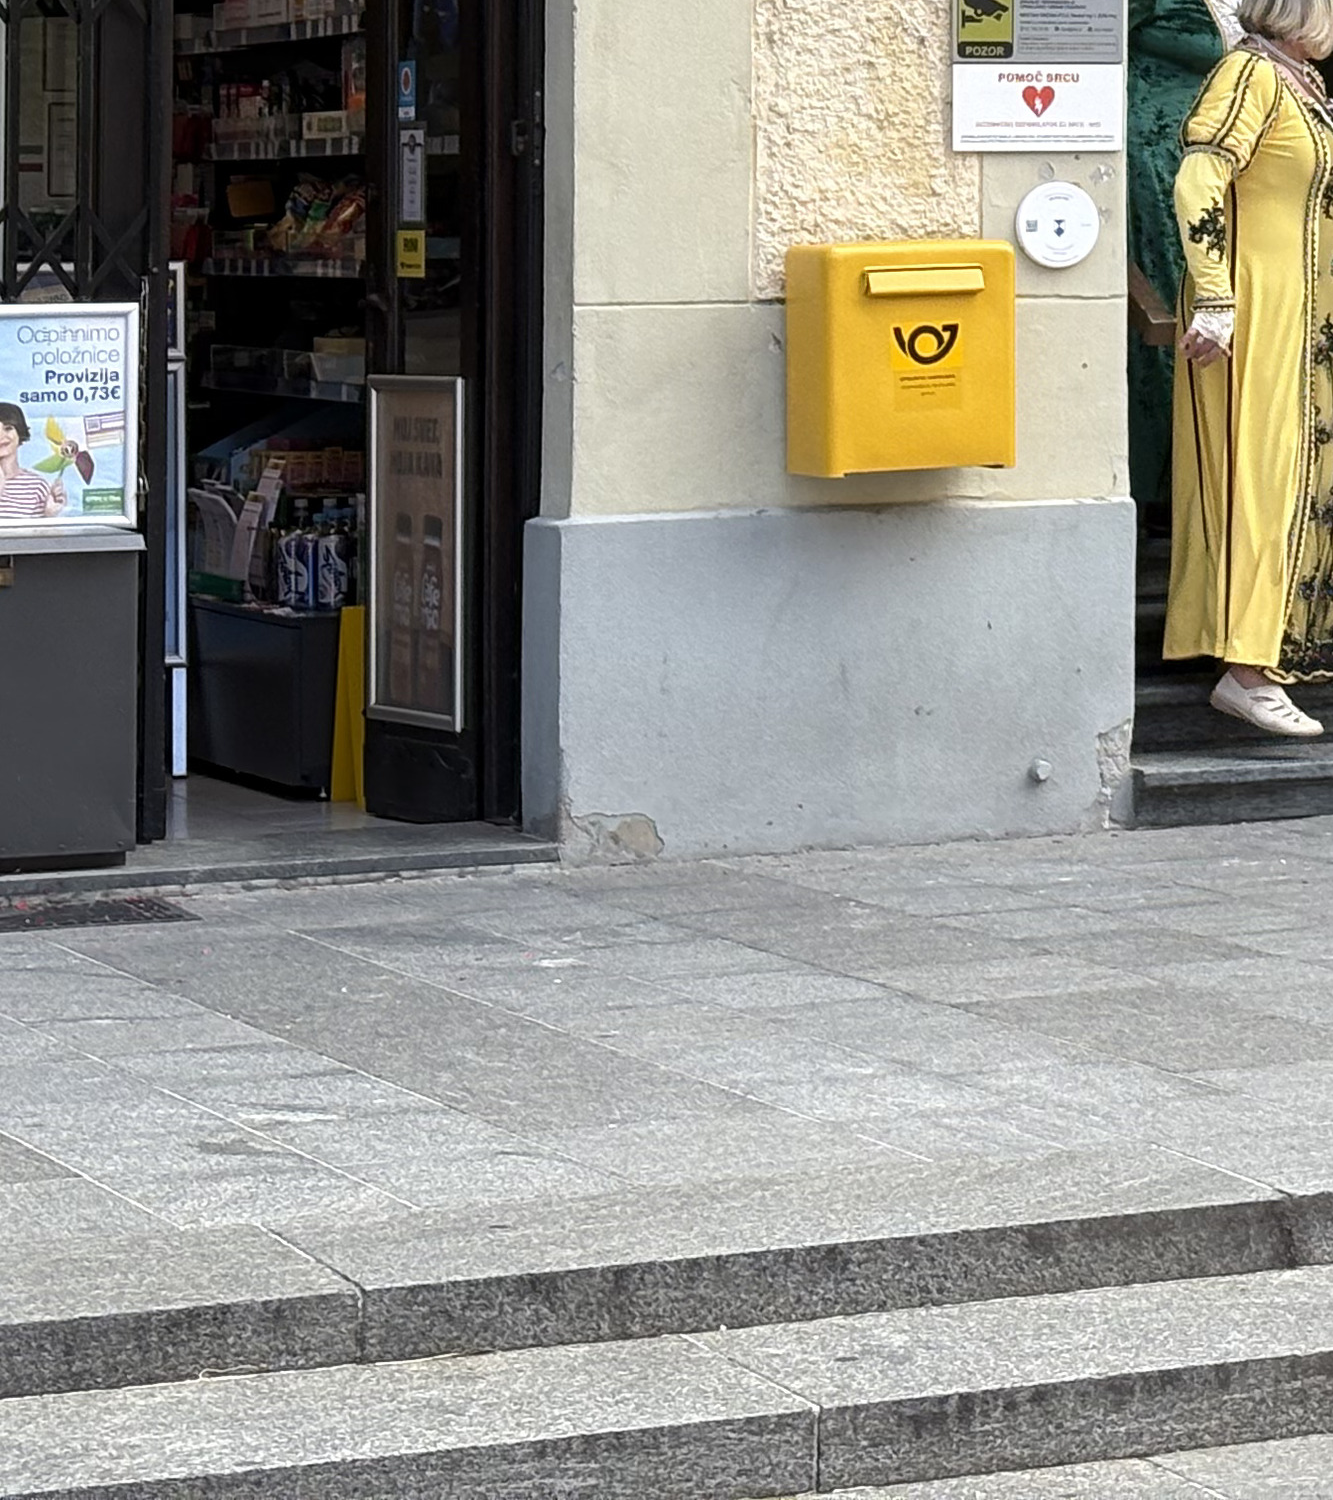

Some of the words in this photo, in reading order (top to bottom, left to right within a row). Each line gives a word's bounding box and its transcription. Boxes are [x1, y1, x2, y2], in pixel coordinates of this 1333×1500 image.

[965, 45, 1005, 57] POZOR
[998, 71, 1043, 82] POMOČ
[17, 325, 120, 345] Odpihnimo
[32, 347, 120, 368] položnice
[45, 368, 120, 385] Provizija
[19, 389, 68, 403] samo
[73, 386, 121, 404] 0,73€
